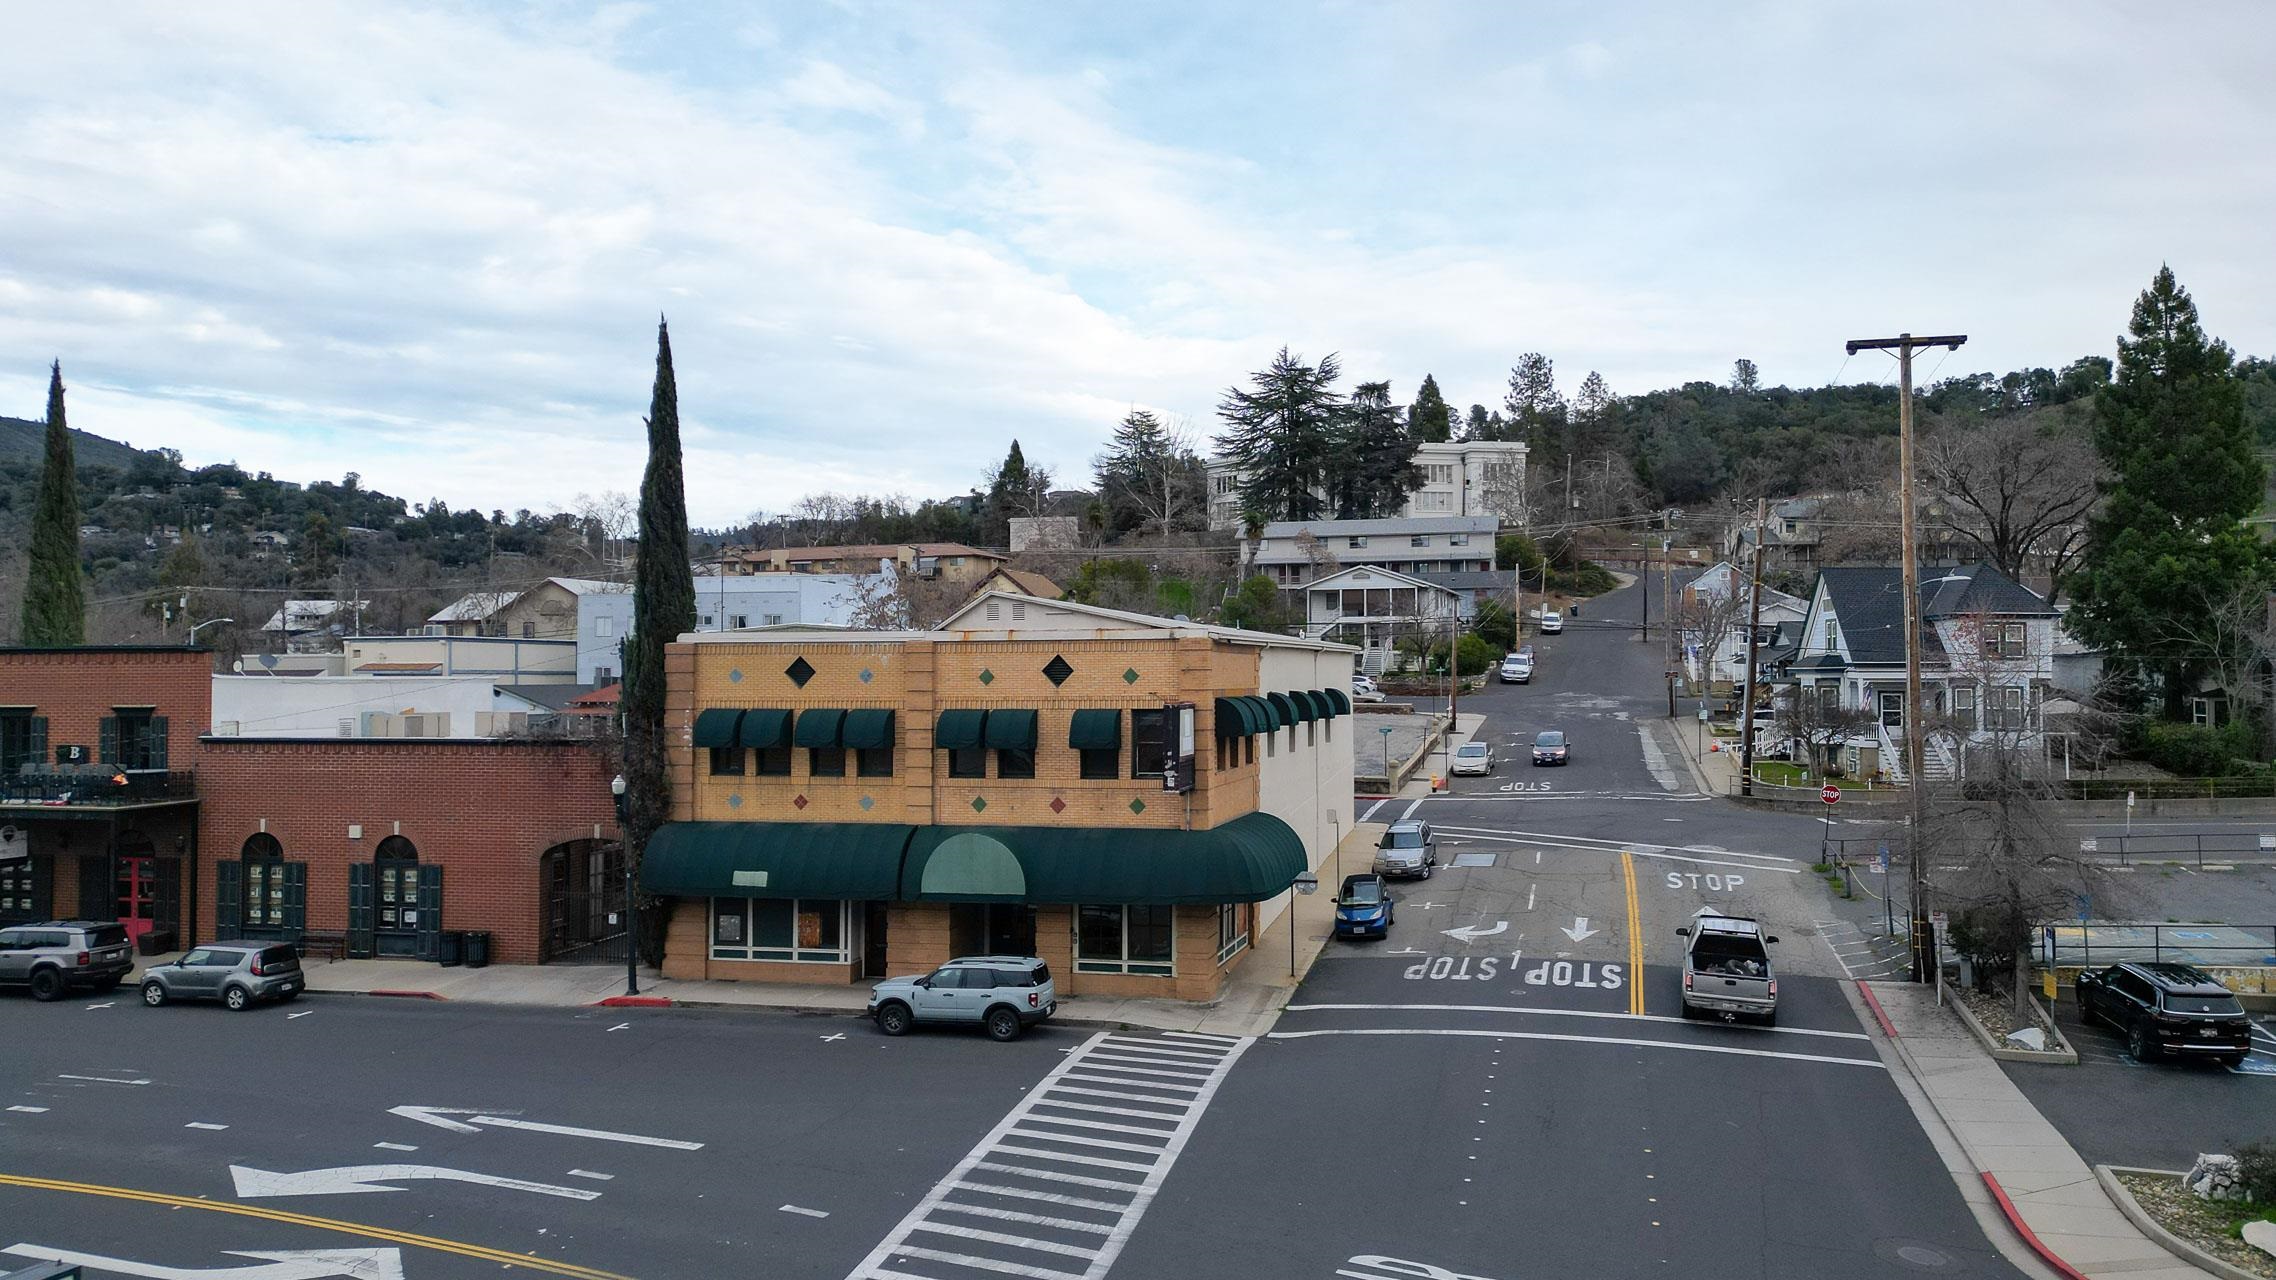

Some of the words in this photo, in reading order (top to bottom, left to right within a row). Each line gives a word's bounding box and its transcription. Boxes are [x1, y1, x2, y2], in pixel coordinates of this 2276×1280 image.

[69, 746, 80, 759] B
[1500, 782, 1551, 791] STOP
[1822, 790, 1840, 799] STOP
[1666, 872, 1745, 892] STOP
[1403, 956, 1499, 981] STOP
[1524, 961, 1622, 989] STOP
